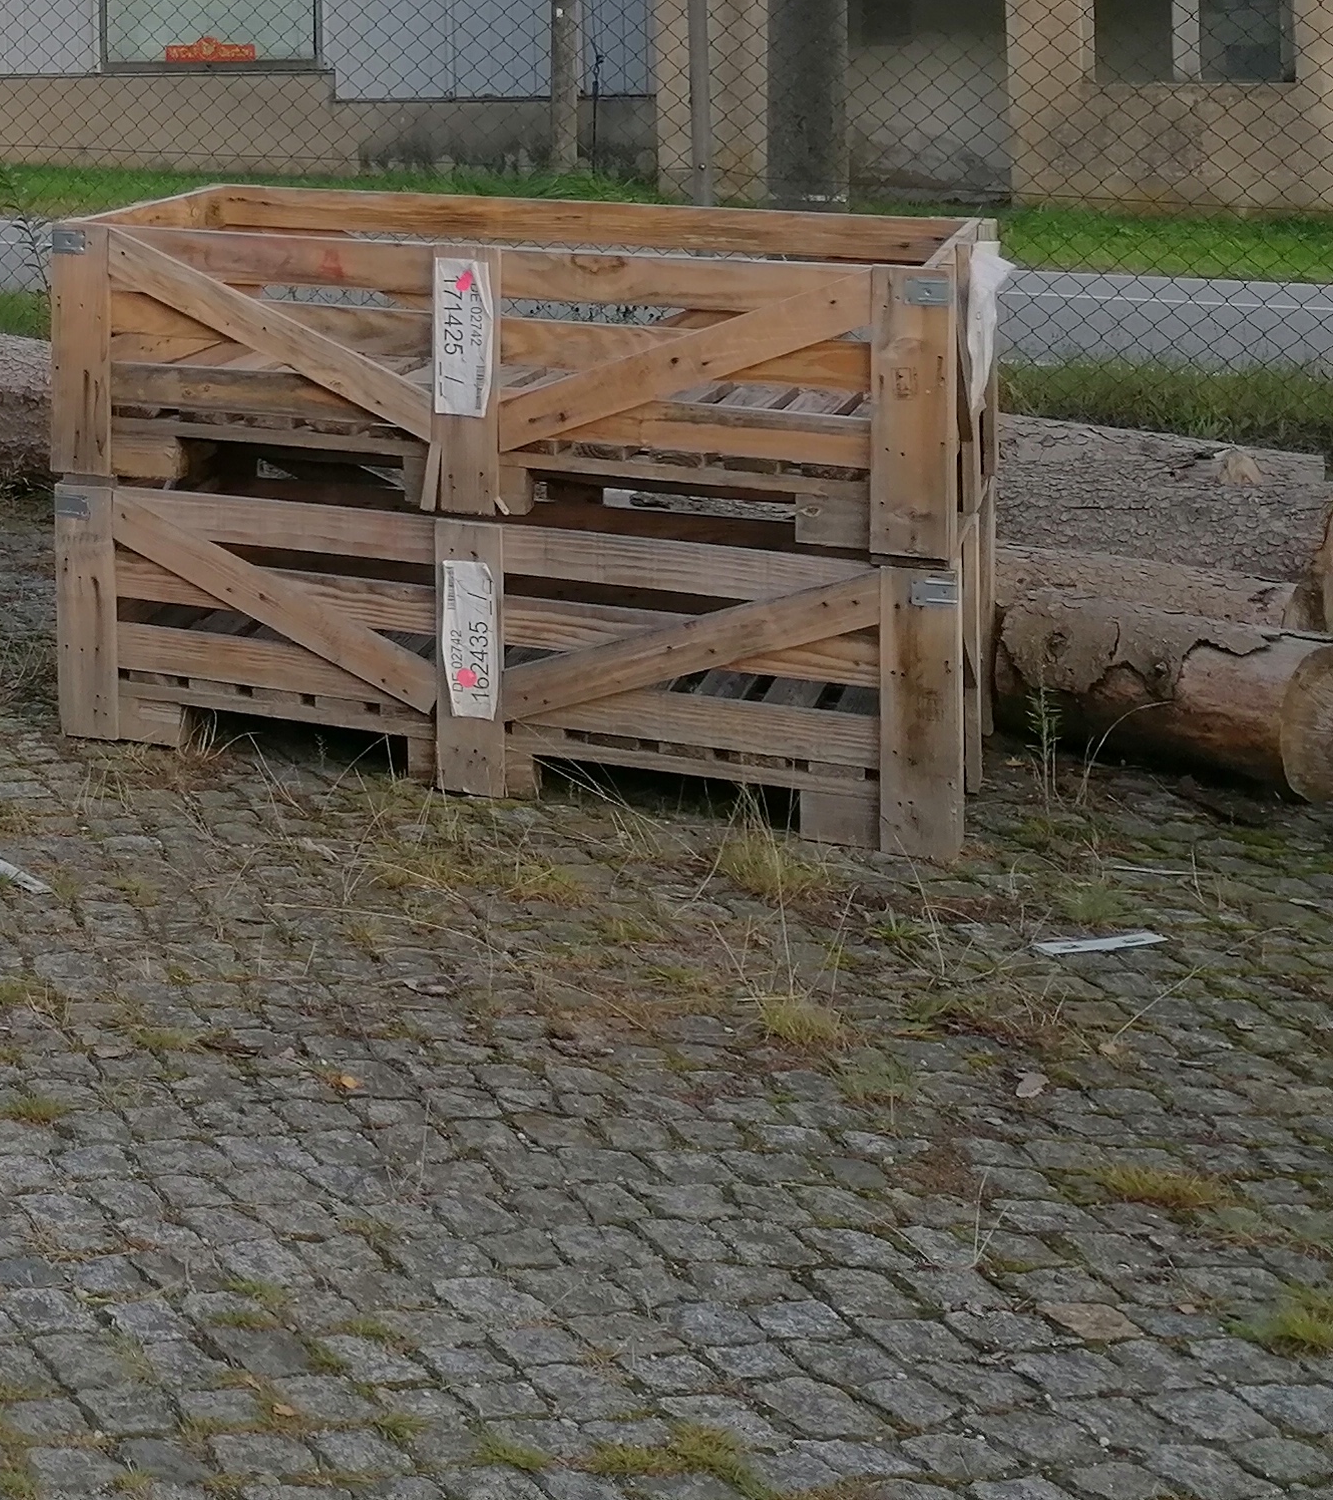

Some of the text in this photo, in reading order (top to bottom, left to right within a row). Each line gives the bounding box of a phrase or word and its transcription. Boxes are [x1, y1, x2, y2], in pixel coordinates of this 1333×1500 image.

[443, 275, 464, 355] 171425
[470, 306, 483, 346] 02742
[450, 629, 463, 669] 02742
[469, 621, 490, 701] 162435
